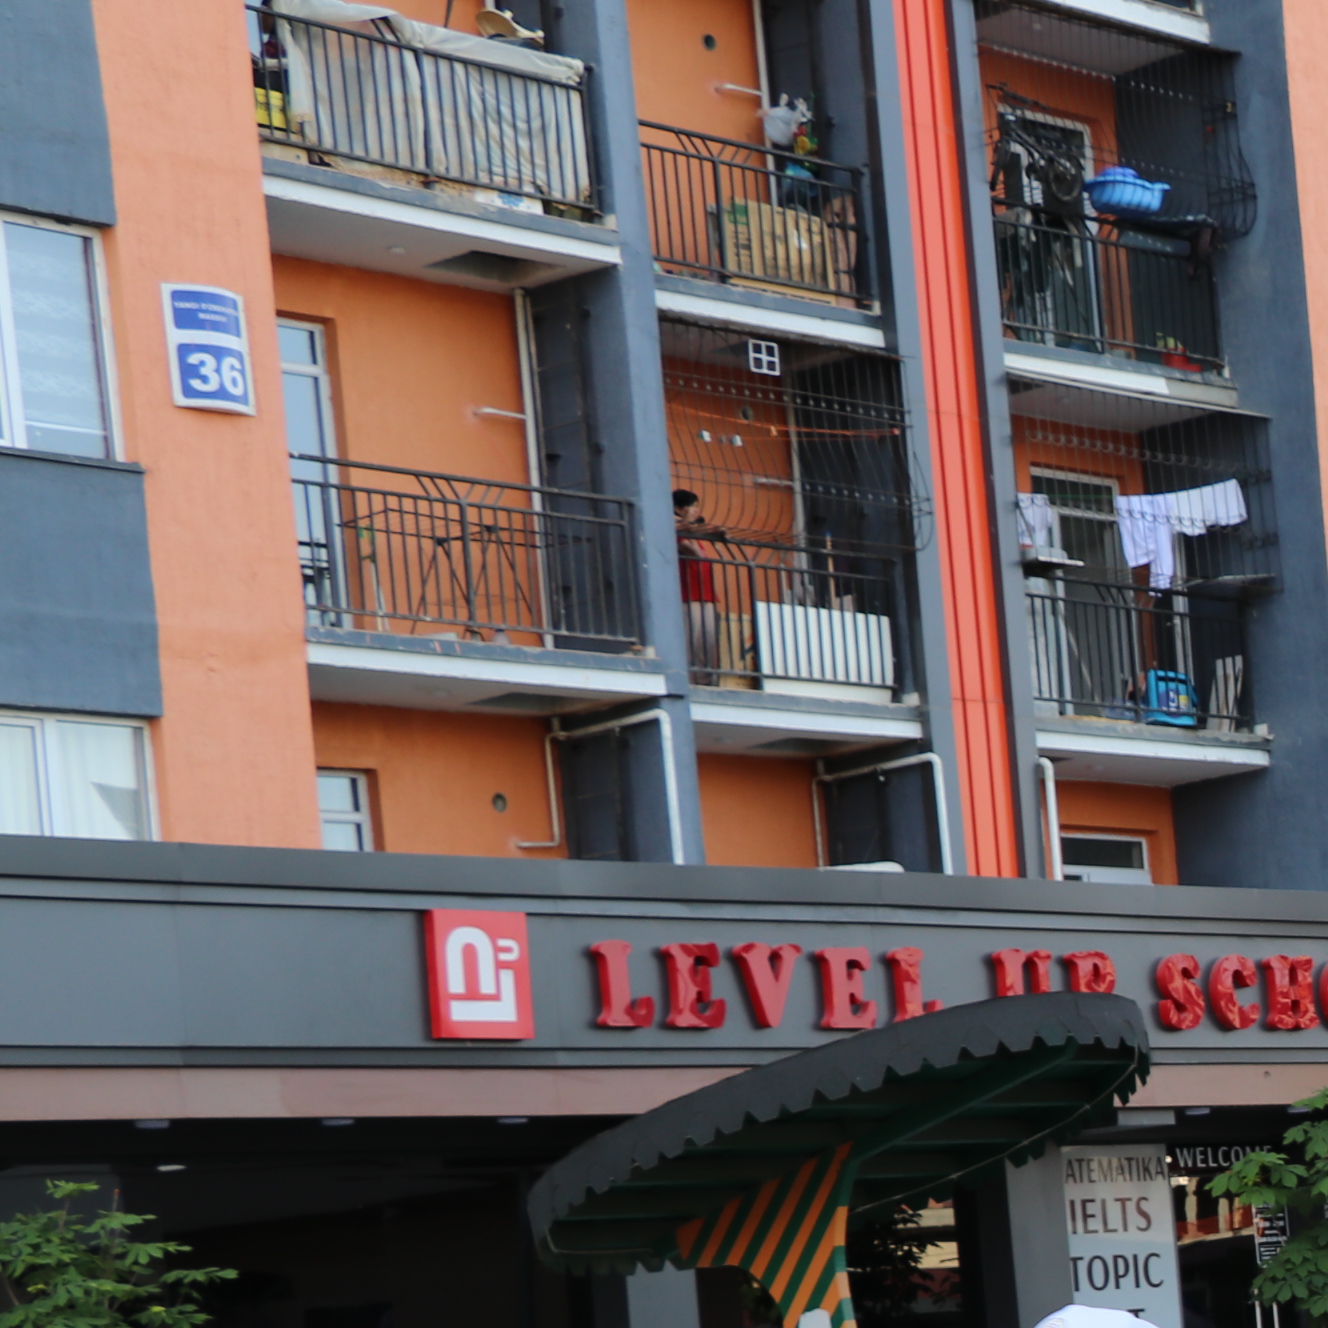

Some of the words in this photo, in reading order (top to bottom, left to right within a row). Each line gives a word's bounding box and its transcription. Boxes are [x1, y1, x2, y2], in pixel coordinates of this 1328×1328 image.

[186, 352, 245, 396] 36
[589, 939, 944, 1029] LEVEL
[1069, 1196, 1152, 1235] IELTS
[1070, 1252, 1164, 1292] TOPIC
